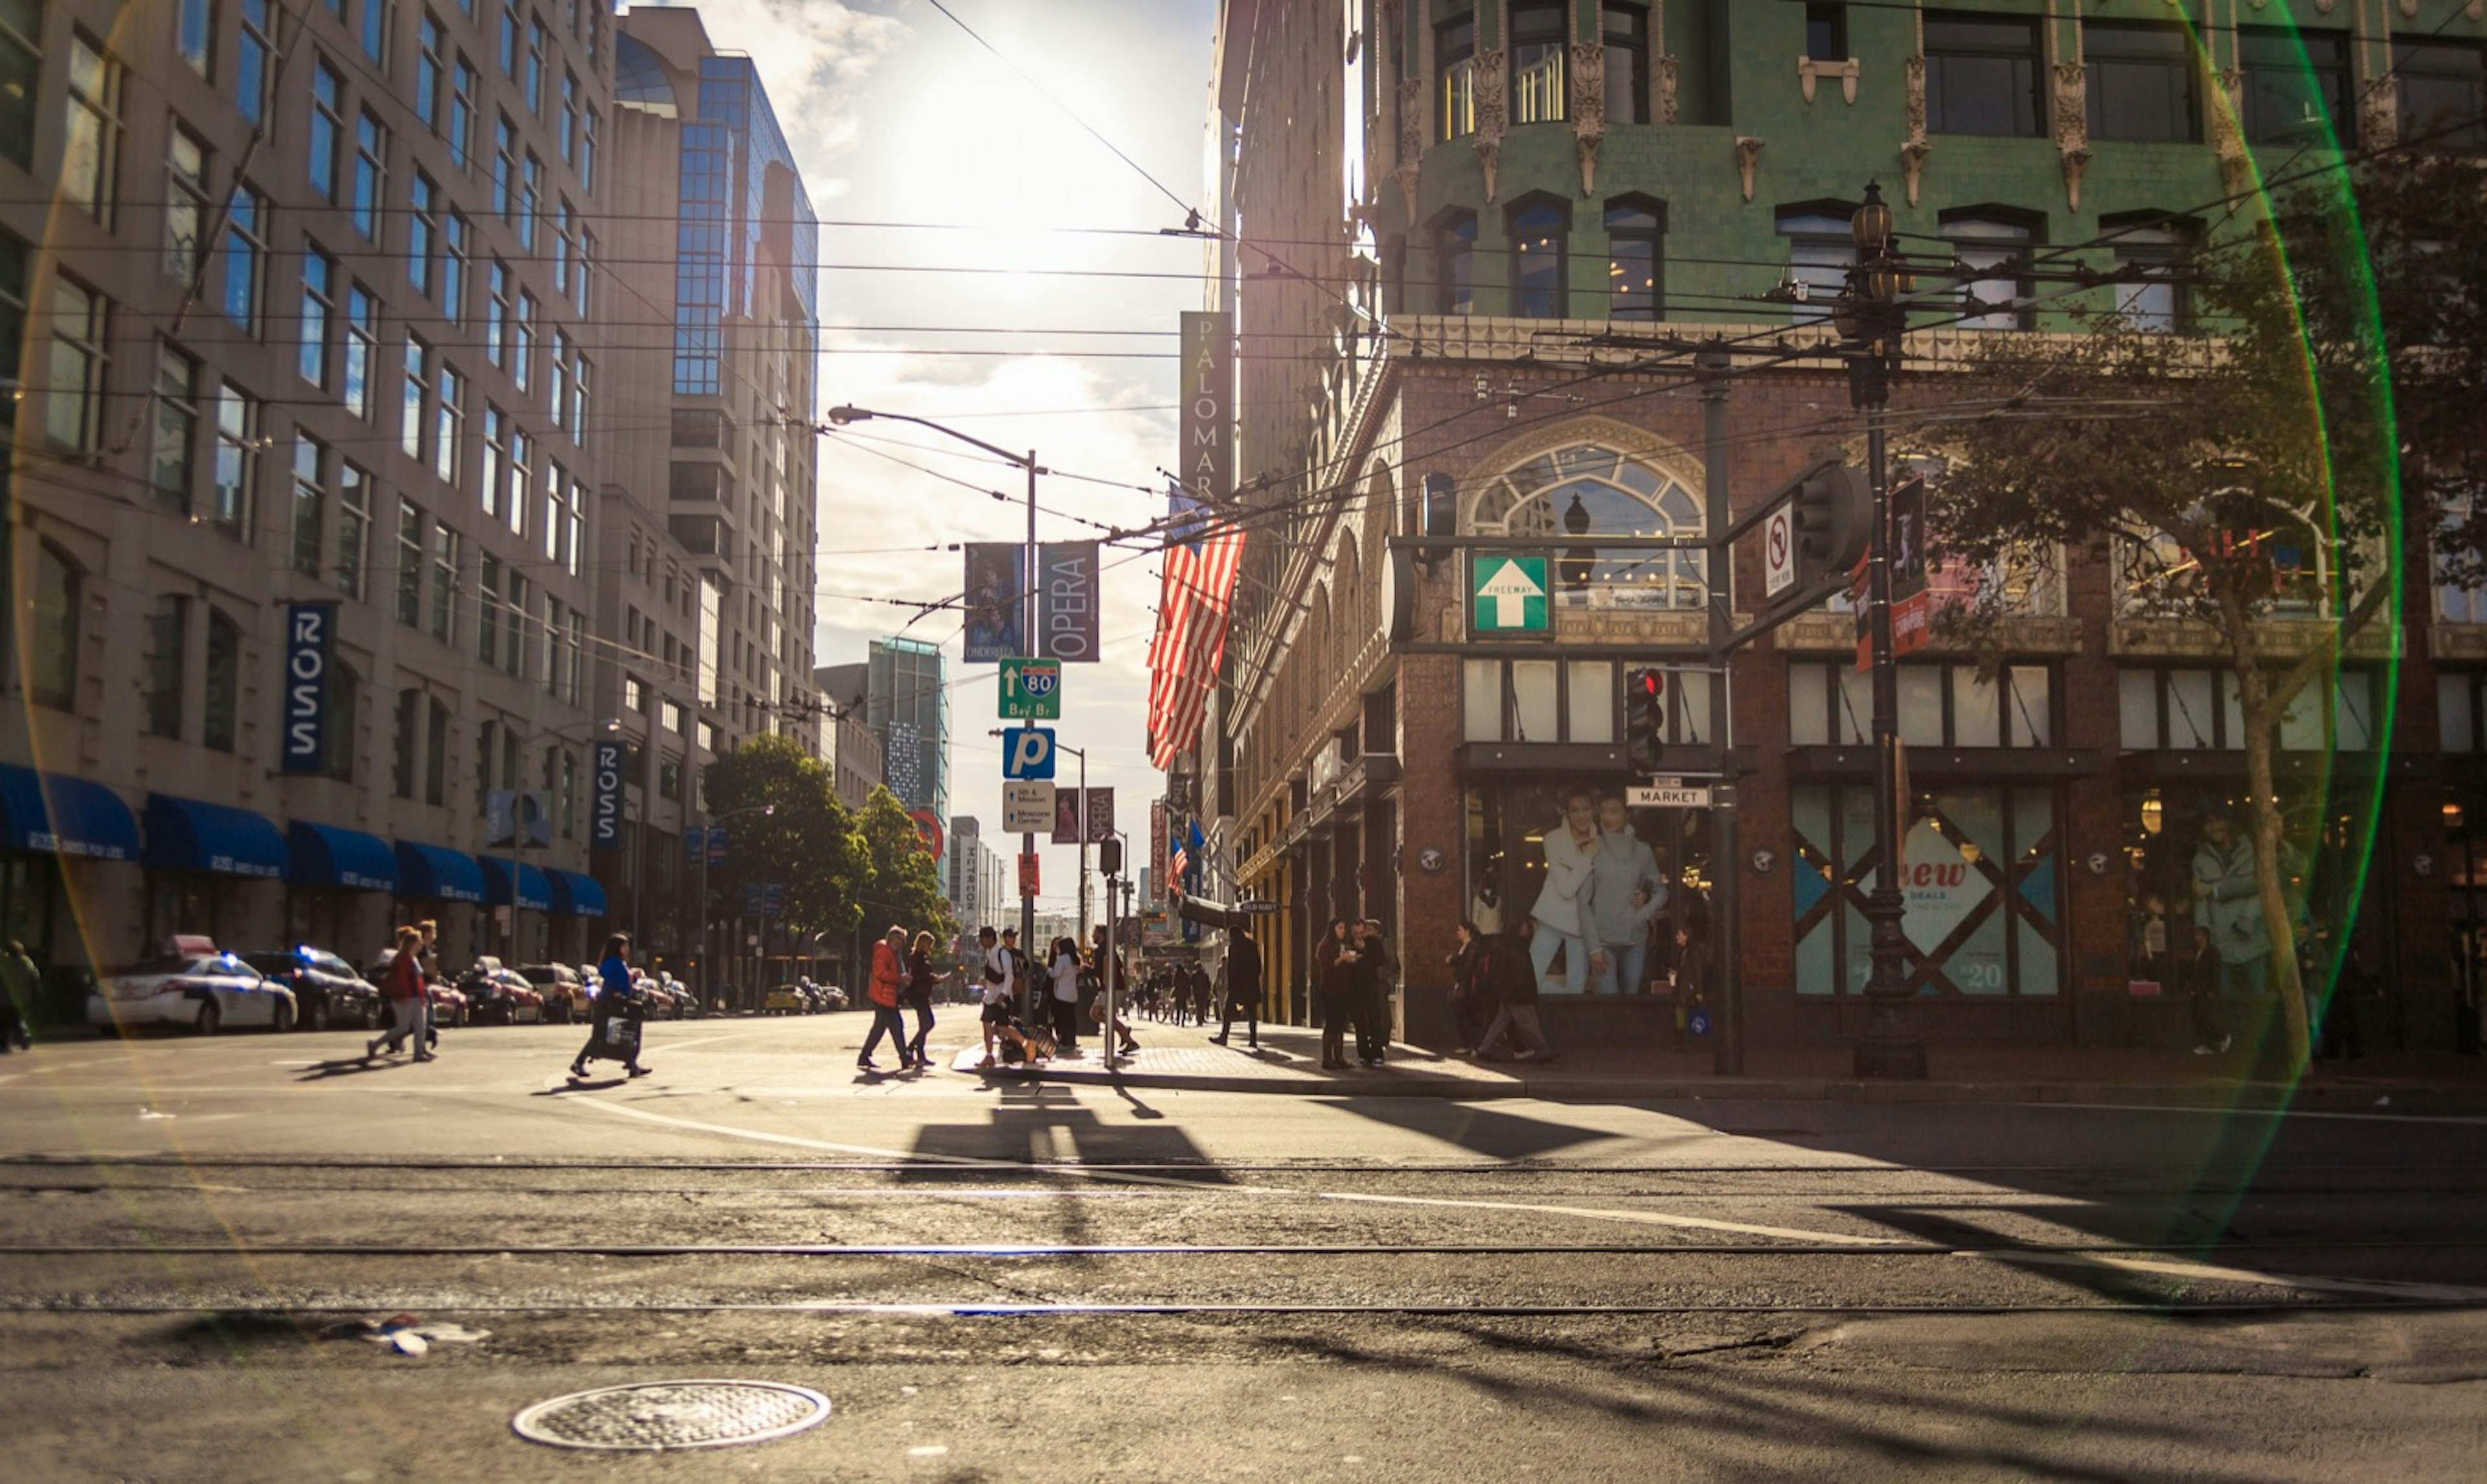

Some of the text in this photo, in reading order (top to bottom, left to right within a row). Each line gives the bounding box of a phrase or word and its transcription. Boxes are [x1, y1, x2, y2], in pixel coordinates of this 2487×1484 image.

[1194, 321, 1218, 497] PALOMAR
[1489, 585, 1532, 594] FREEWAY
[1050, 557, 1087, 657] OPERA
[291, 612, 322, 756] ROSS
[1028, 675, 1051, 692] 80
[1009, 703, 1049, 717] Bay Br
[598, 748, 618, 838] ROSS
[1641, 791, 1697, 802] MARKET
[1909, 891, 1946, 899] DEALS
